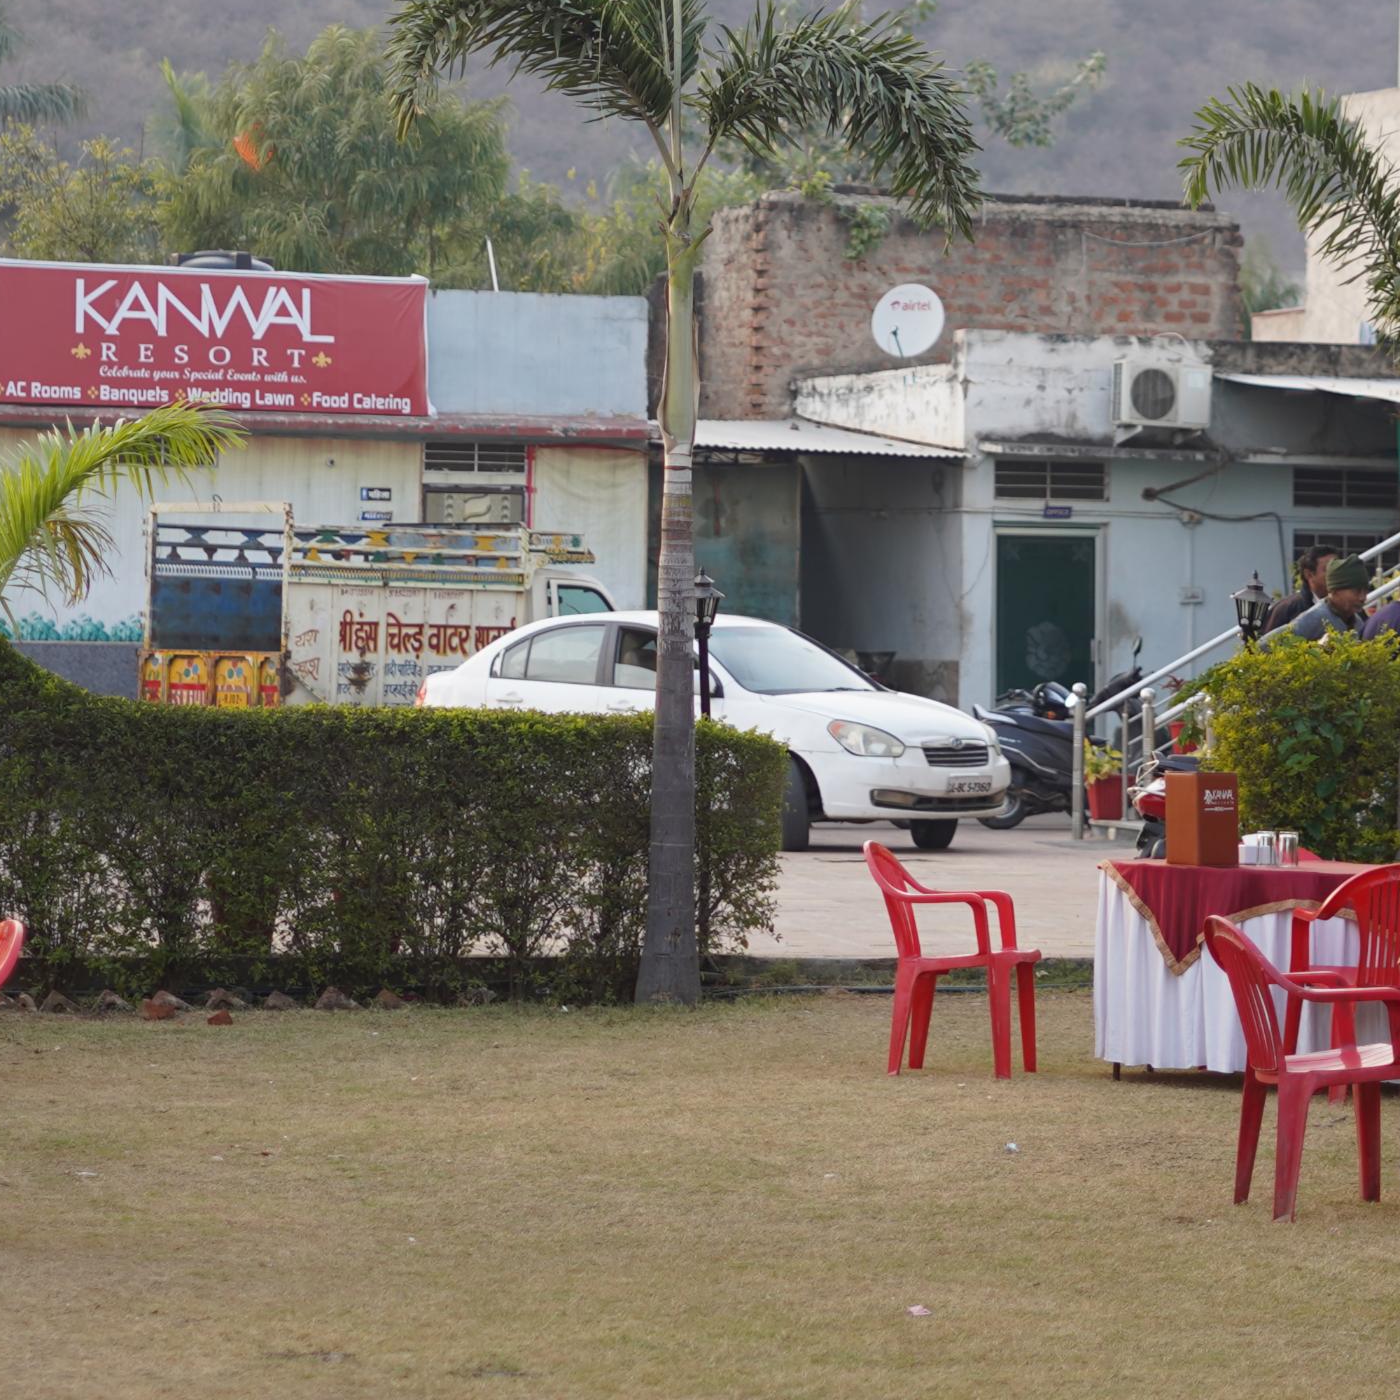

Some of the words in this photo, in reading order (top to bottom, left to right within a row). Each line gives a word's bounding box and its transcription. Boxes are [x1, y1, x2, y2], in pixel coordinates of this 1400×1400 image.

[75, 278, 335, 343] KANWAL
[902, 300, 931, 311] airtel
[100, 342, 307, 368] RESORT
[99, 365, 150, 378] Celebrate
[153, 369, 180, 381] your
[183, 368, 224, 382] Special
[227, 369, 261, 381] Events
[264, 371, 288, 383] with
[290, 373, 307, 384] us.
[6, 380, 27, 397] AC
[31, 383, 81, 399] Rooms
[100, 384, 169, 405] Banquets
[187, 386, 251, 408] Wedding
[255, 389, 295, 406] Lawn
[312, 391, 349, 408] Food
[353, 393, 411, 414] Catering
